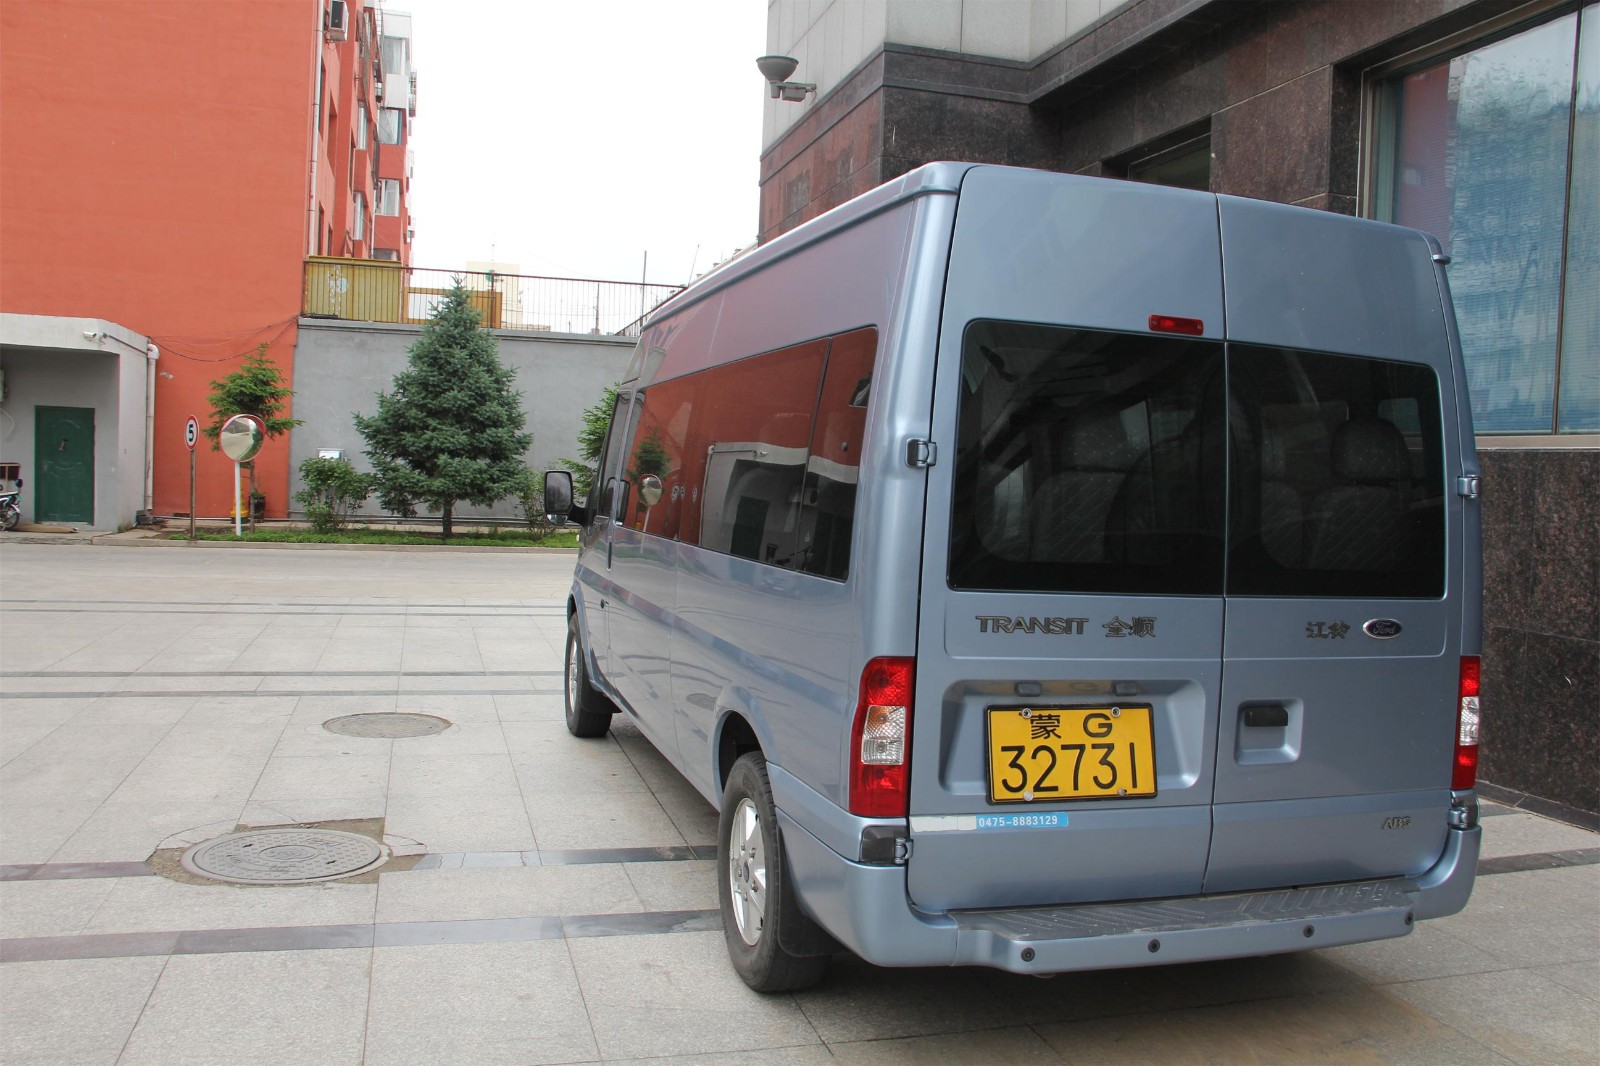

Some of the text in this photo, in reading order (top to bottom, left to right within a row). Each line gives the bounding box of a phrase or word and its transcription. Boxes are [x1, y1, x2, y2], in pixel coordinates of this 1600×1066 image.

[188, 423, 195, 443] 5
[975, 615, 1157, 638] TRANSIT 全顺
[1030, 713, 1113, 740] 蒙 G
[1000, 742, 1138, 793] 32731
[979, 815, 1058, 828] 0475-8883129
[1381, 816, 1412, 830] ABS
